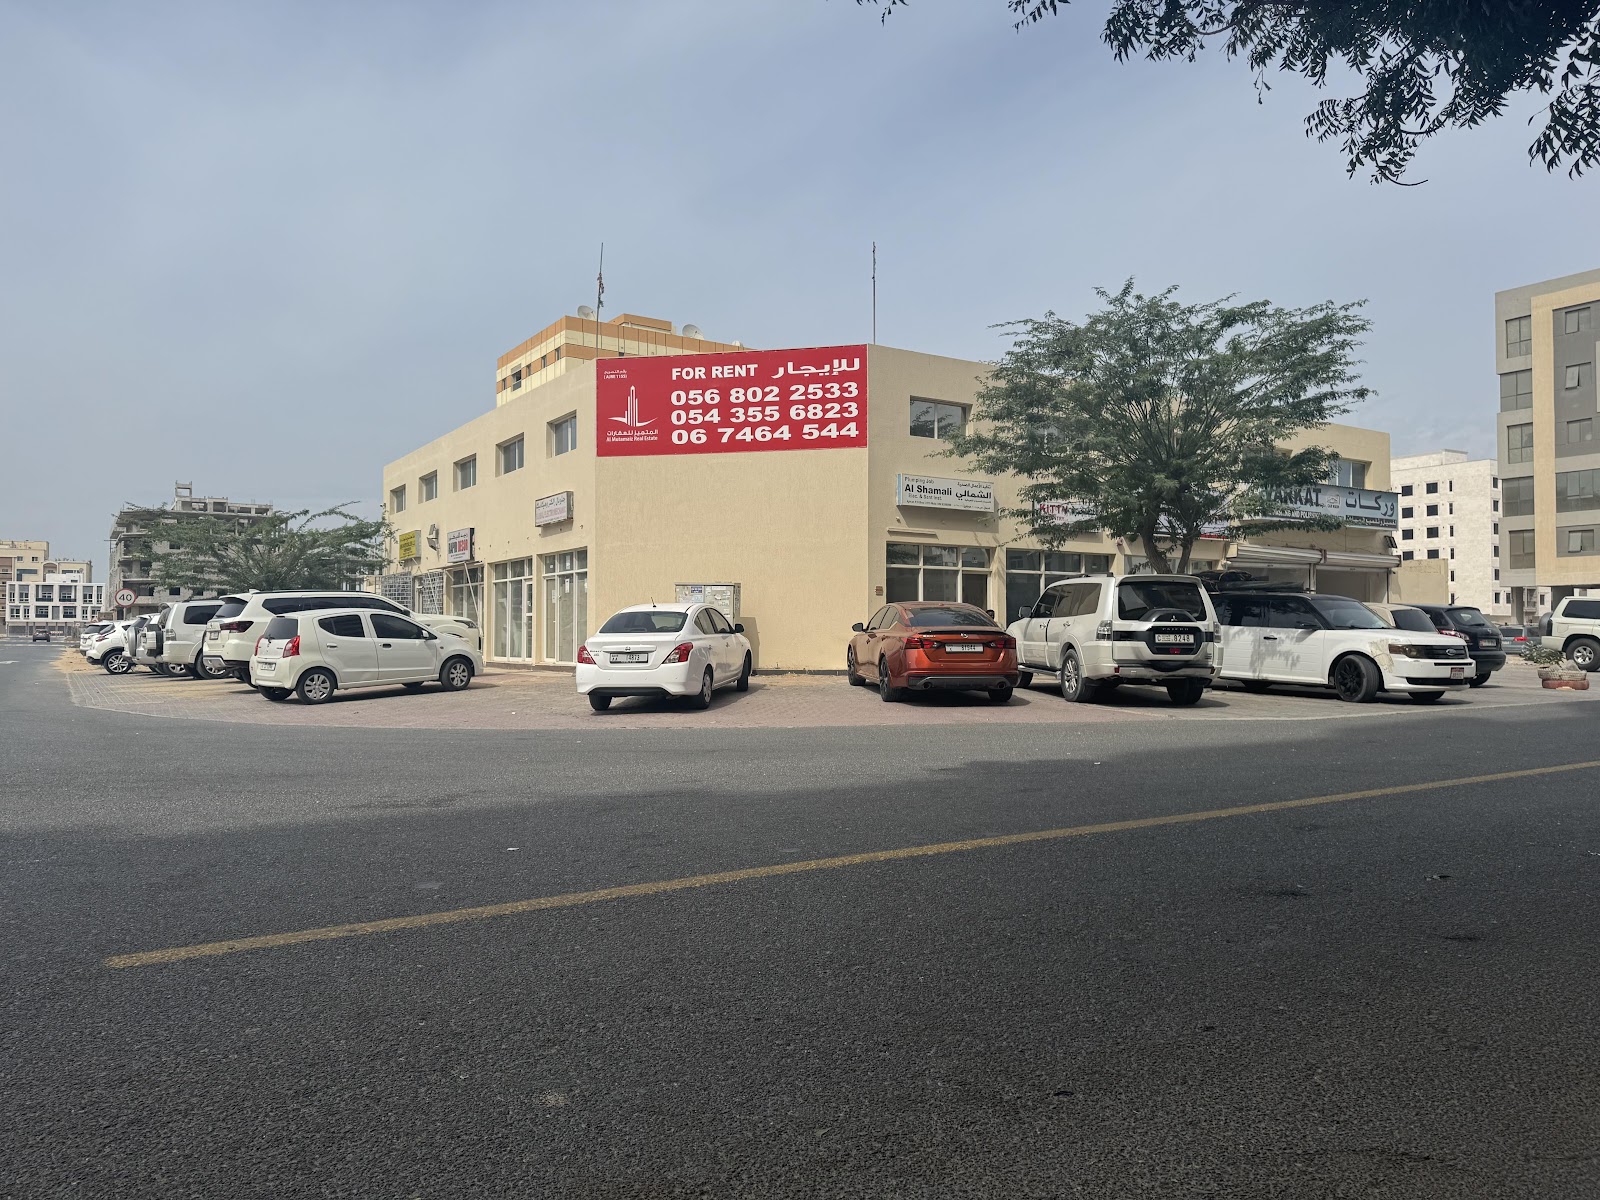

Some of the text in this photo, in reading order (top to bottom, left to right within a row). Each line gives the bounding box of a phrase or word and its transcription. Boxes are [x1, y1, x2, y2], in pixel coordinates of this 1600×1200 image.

[672, 364, 758, 380] FOR RENT
[771, 357, 860, 379] للإيجار
[671, 382, 859, 406] 056 802 2533
[671, 402, 859, 425] 054 355 6823
[671, 421, 859, 445] 06 7464 544
[904, 484, 952, 496] Al Shamali
[955, 489, 992, 501] الشمالي
[1345, 491, 1395, 517] وركات
